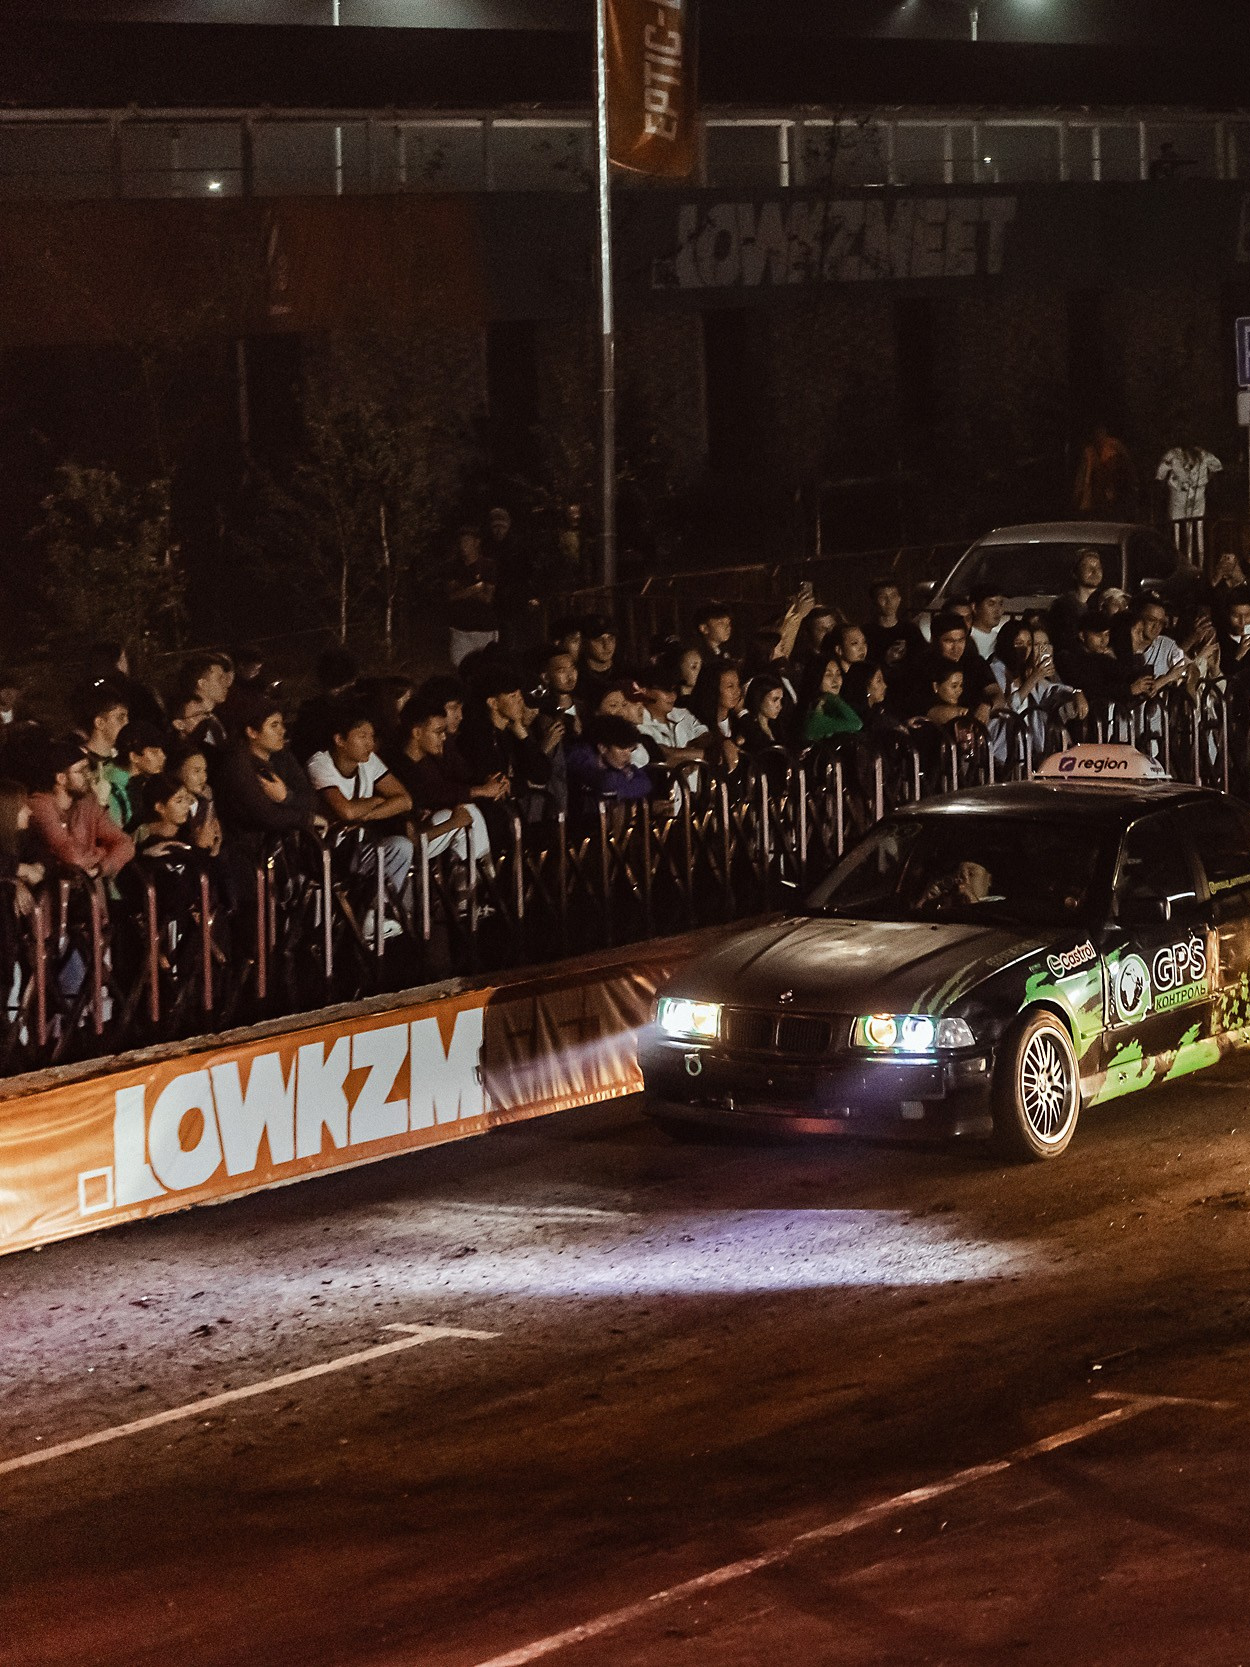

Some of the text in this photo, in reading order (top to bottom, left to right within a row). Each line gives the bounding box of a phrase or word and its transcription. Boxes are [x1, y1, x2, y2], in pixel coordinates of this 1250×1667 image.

[643, 0, 682, 141] EPTIC-
[1077, 757, 1128, 773] region
[1060, 940, 1097, 971] Castrol
[1153, 938, 1207, 991] GPS
[1155, 982, 1207, 1010] КОНТРОЛЬ
